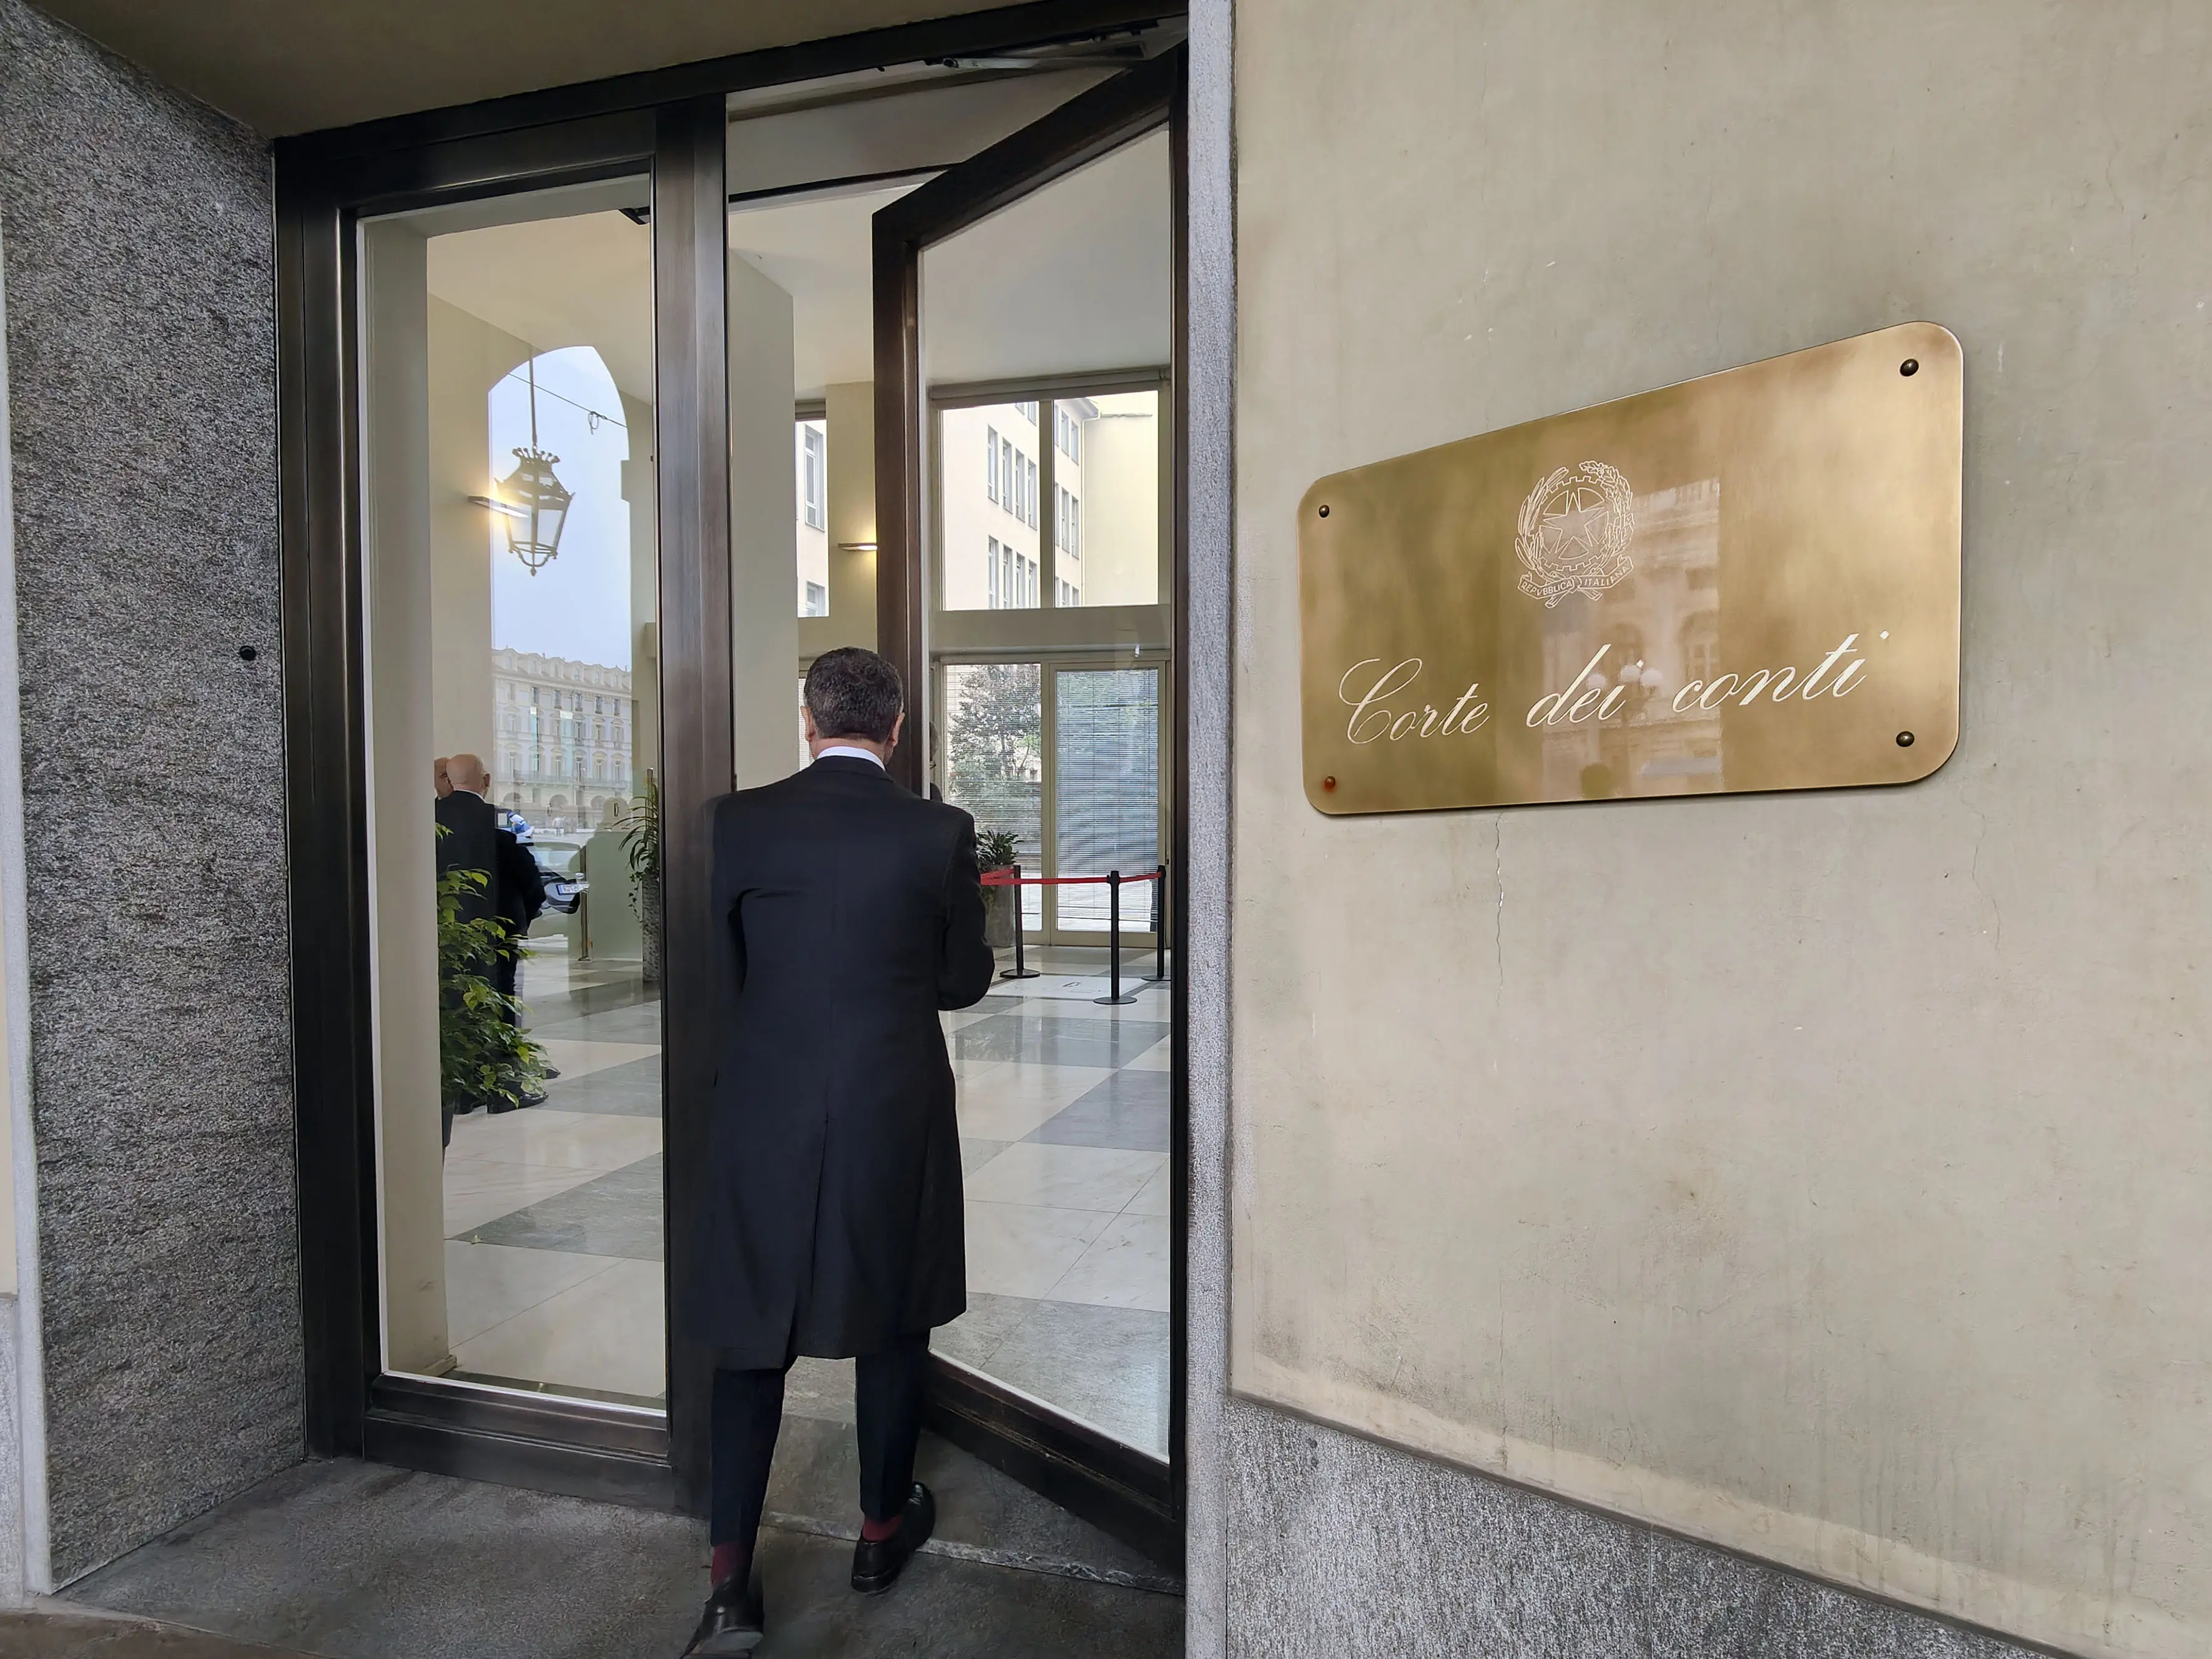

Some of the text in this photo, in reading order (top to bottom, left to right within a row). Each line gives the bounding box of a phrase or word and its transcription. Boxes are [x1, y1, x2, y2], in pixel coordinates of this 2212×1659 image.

[1583, 565, 1631, 586] ITALIANA
[1339, 631, 1890, 744] Corte dei conti
